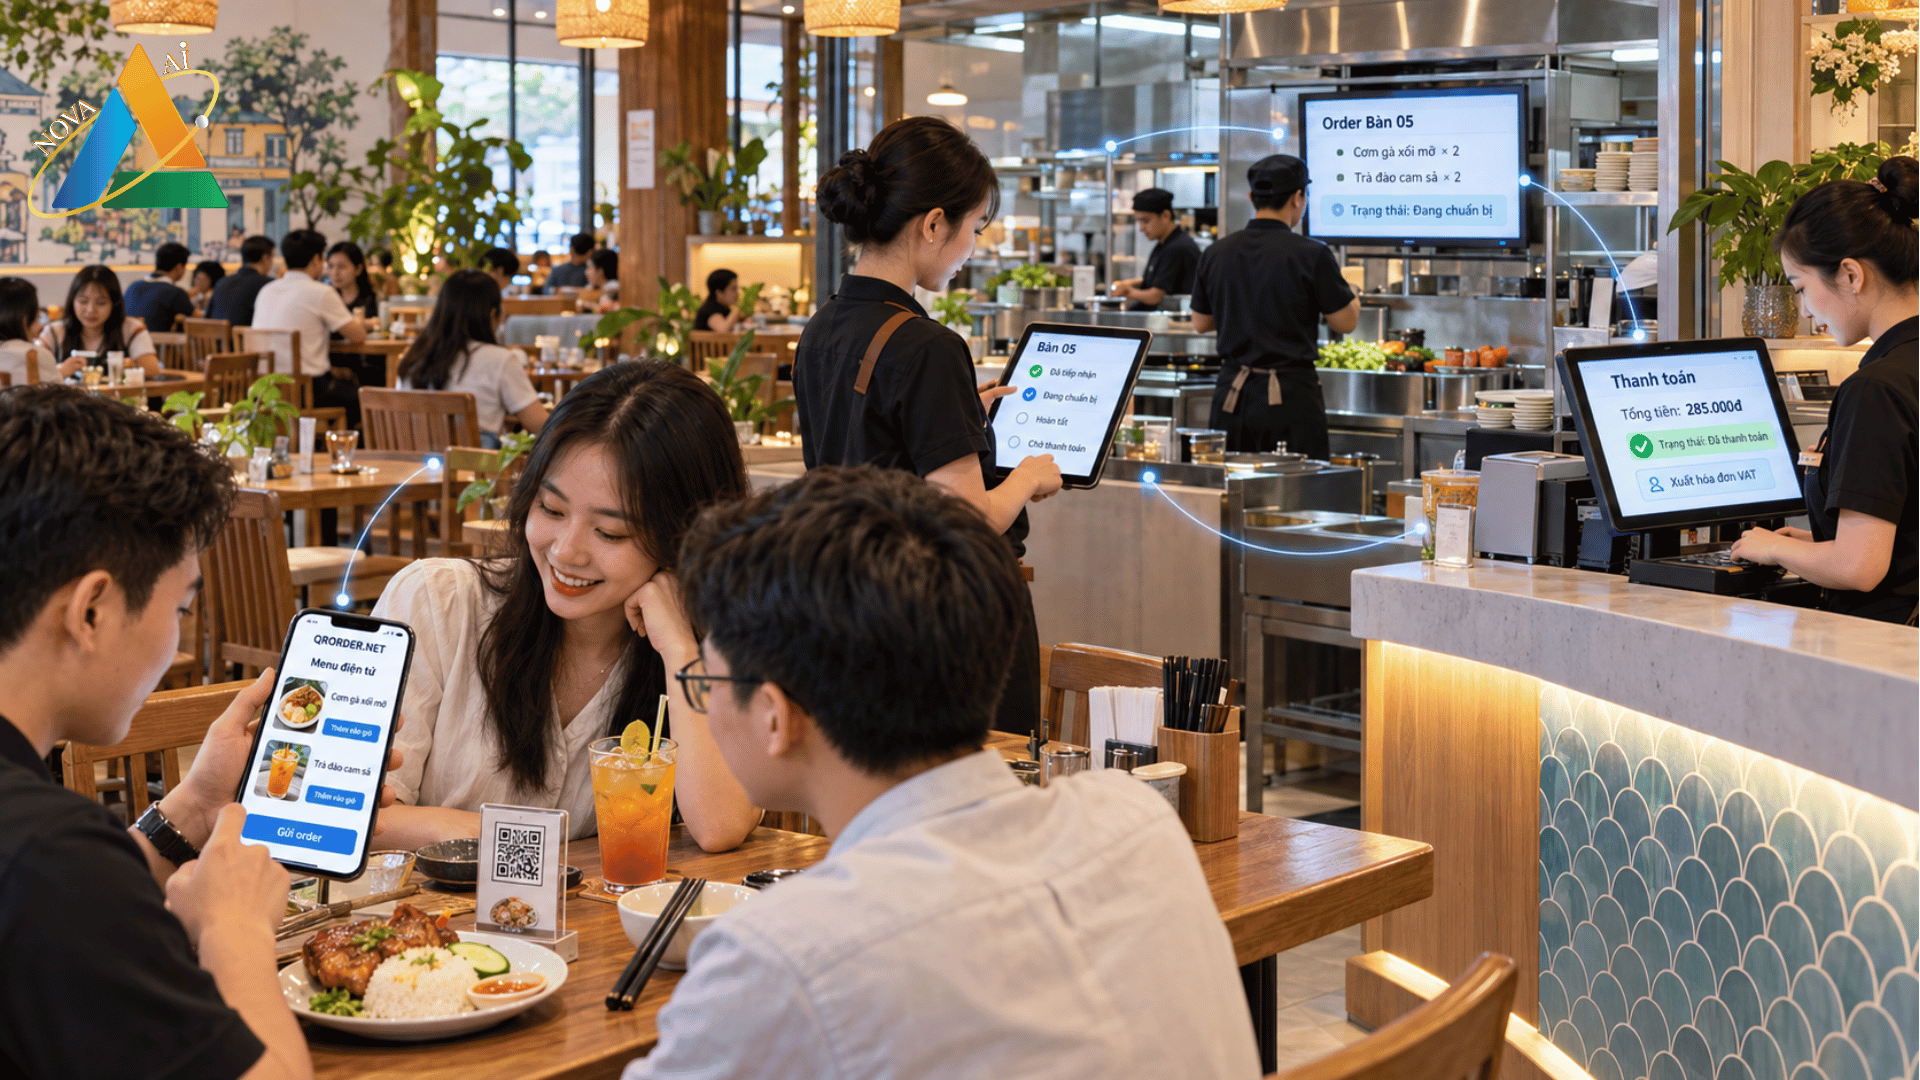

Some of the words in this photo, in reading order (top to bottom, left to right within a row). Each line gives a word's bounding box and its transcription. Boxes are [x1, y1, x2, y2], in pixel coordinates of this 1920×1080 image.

[1322, 116, 1362, 130] Order
[1366, 115, 1392, 129] Bàn
[1396, 115, 1414, 128] 05
[1353, 146, 1379, 158] Cơm
[1381, 146, 1395, 160] gà
[1398, 145, 1415, 157] xối
[1418, 145, 1437, 157] mỡ
[1452, 145, 1460, 157] 2
[1354, 171, 1373, 183] Trà
[1375, 171, 1397, 183] đào
[1399, 174, 1423, 183] cam
[1454, 171, 1461, 183] 2
[1351, 204, 1383, 219] Trạng
[1385, 204, 1410, 216] thái:
[1413, 204, 1443, 219] Đang
[1445, 203, 1479, 216] chuẩn
[1482, 204, 1493, 219] bị
[1061, 343, 1077, 354] 05
[1061, 368, 1077, 379] tiếp
[1077, 370, 1097, 380] nhận
[1610, 372, 1660, 389] Thanh
[1661, 369, 1696, 386] toán
[1043, 391, 1064, 402] Đang
[1089, 394, 1098, 404] bị
[1620, 406, 1652, 421] Tổng
[1653, 405, 1681, 418] tiền:
[1685, 399, 1743, 416] 285.000đ
[1045, 442, 1067, 451] thanh
[1068, 443, 1086, 452] toán
[1658, 438, 1685, 450] Trạng
[1722, 433, 1747, 444] thanh
[1670, 474, 1694, 488] Xuất
[1717, 471, 1736, 483] đơn
[1737, 469, 1756, 481] VAT
[313, 634, 387, 654] QRORDER.NET
[310, 657, 338, 670] Menu
[340, 662, 363, 675] điện
[343, 766, 360, 775] cam
[295, 831, 322, 843] order
